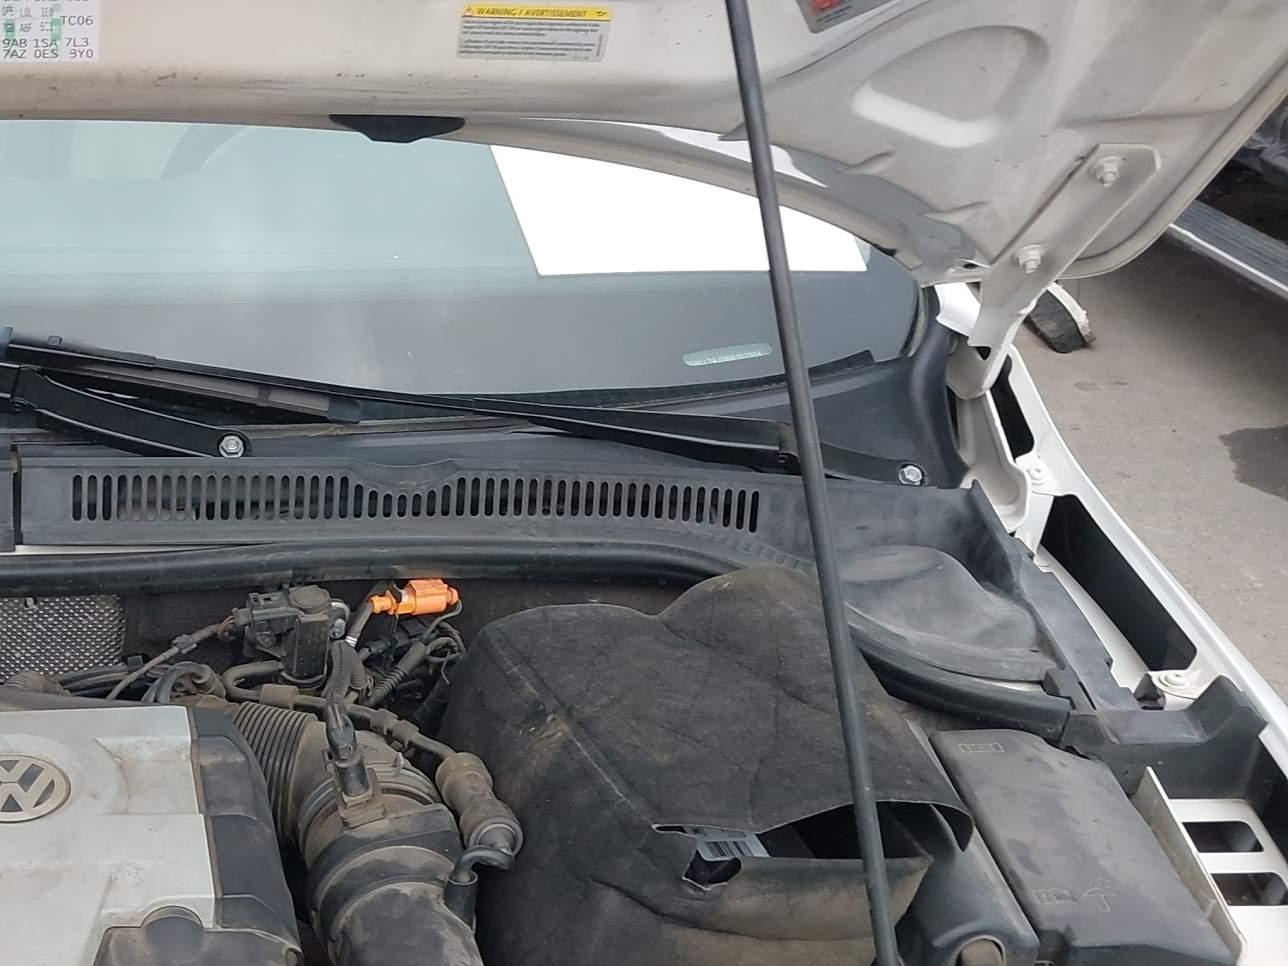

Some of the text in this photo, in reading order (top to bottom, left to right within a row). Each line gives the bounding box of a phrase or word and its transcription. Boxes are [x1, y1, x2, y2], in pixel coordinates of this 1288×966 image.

[477, 7, 517, 16] WARNING
[525, 8, 587, 18] AVERTISSEMENT
[60, 15, 94, 26] TC06
[2, 37, 89, 48] 9AB 1SA 7L3
[3, 49, 27, 59] 7AZ
